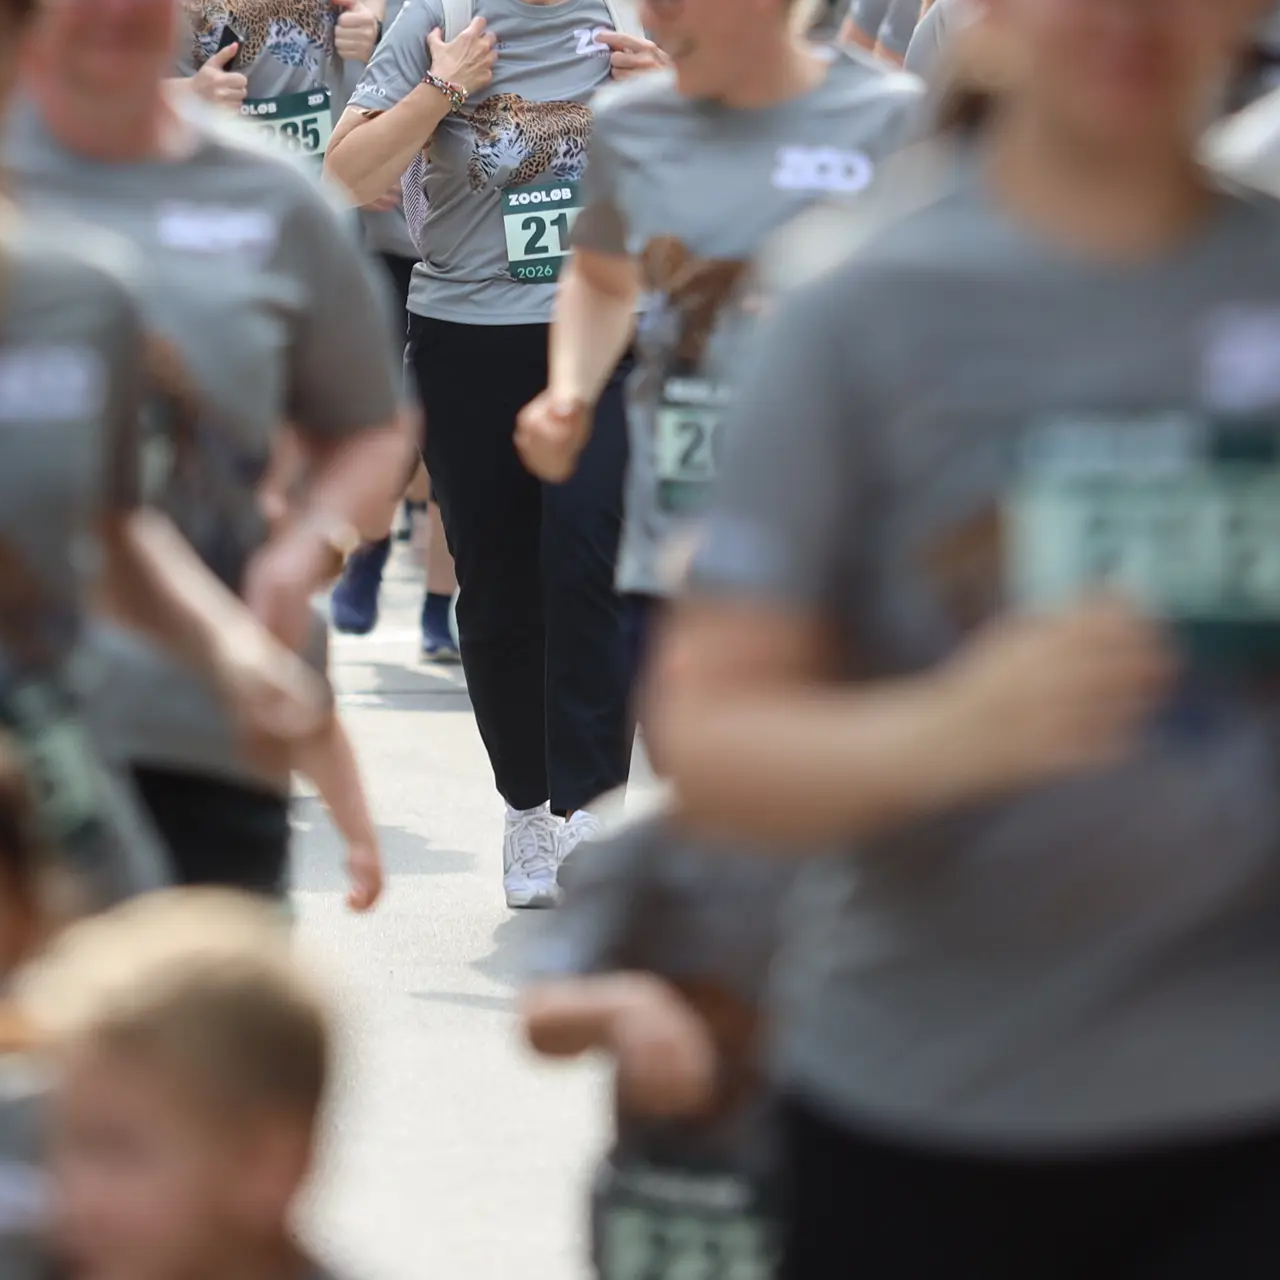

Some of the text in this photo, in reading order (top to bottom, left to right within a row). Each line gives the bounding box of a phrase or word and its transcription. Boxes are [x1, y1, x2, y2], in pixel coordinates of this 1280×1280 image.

[508, 187, 572, 206] ZOOLØB
[521, 212, 570, 256] 21
[517, 264, 553, 279] 2026
